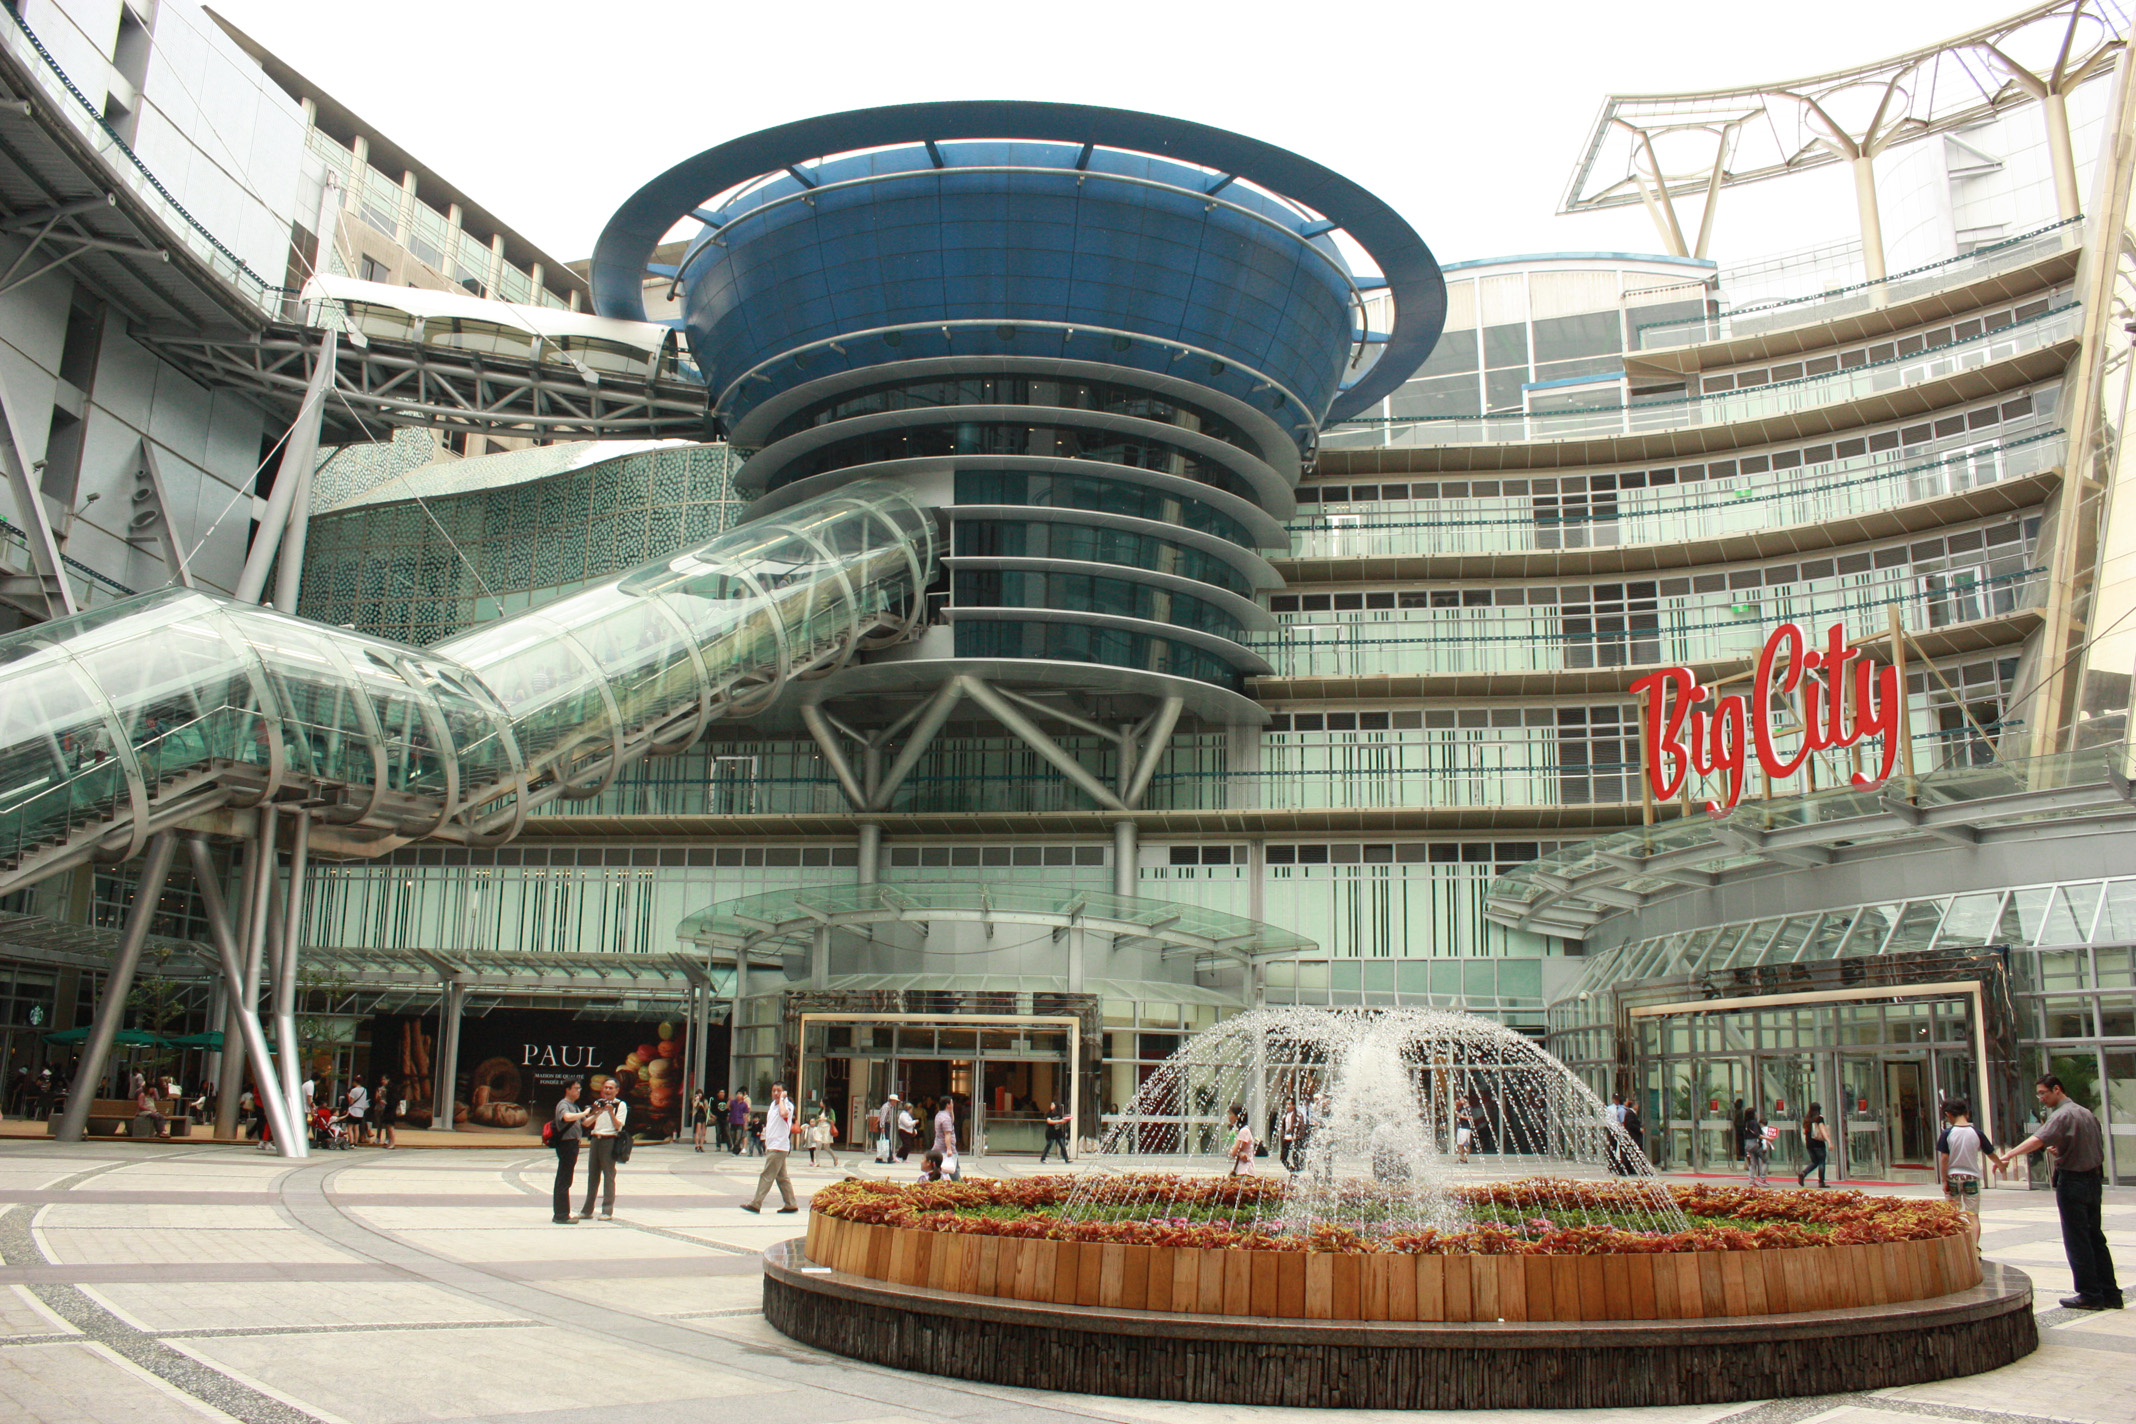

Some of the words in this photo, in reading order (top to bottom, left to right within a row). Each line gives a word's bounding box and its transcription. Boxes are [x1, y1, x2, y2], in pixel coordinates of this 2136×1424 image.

[1629, 667, 1747, 820] Big
[1752, 622, 1900, 793] City
[521, 1043, 603, 1068] PAUL
